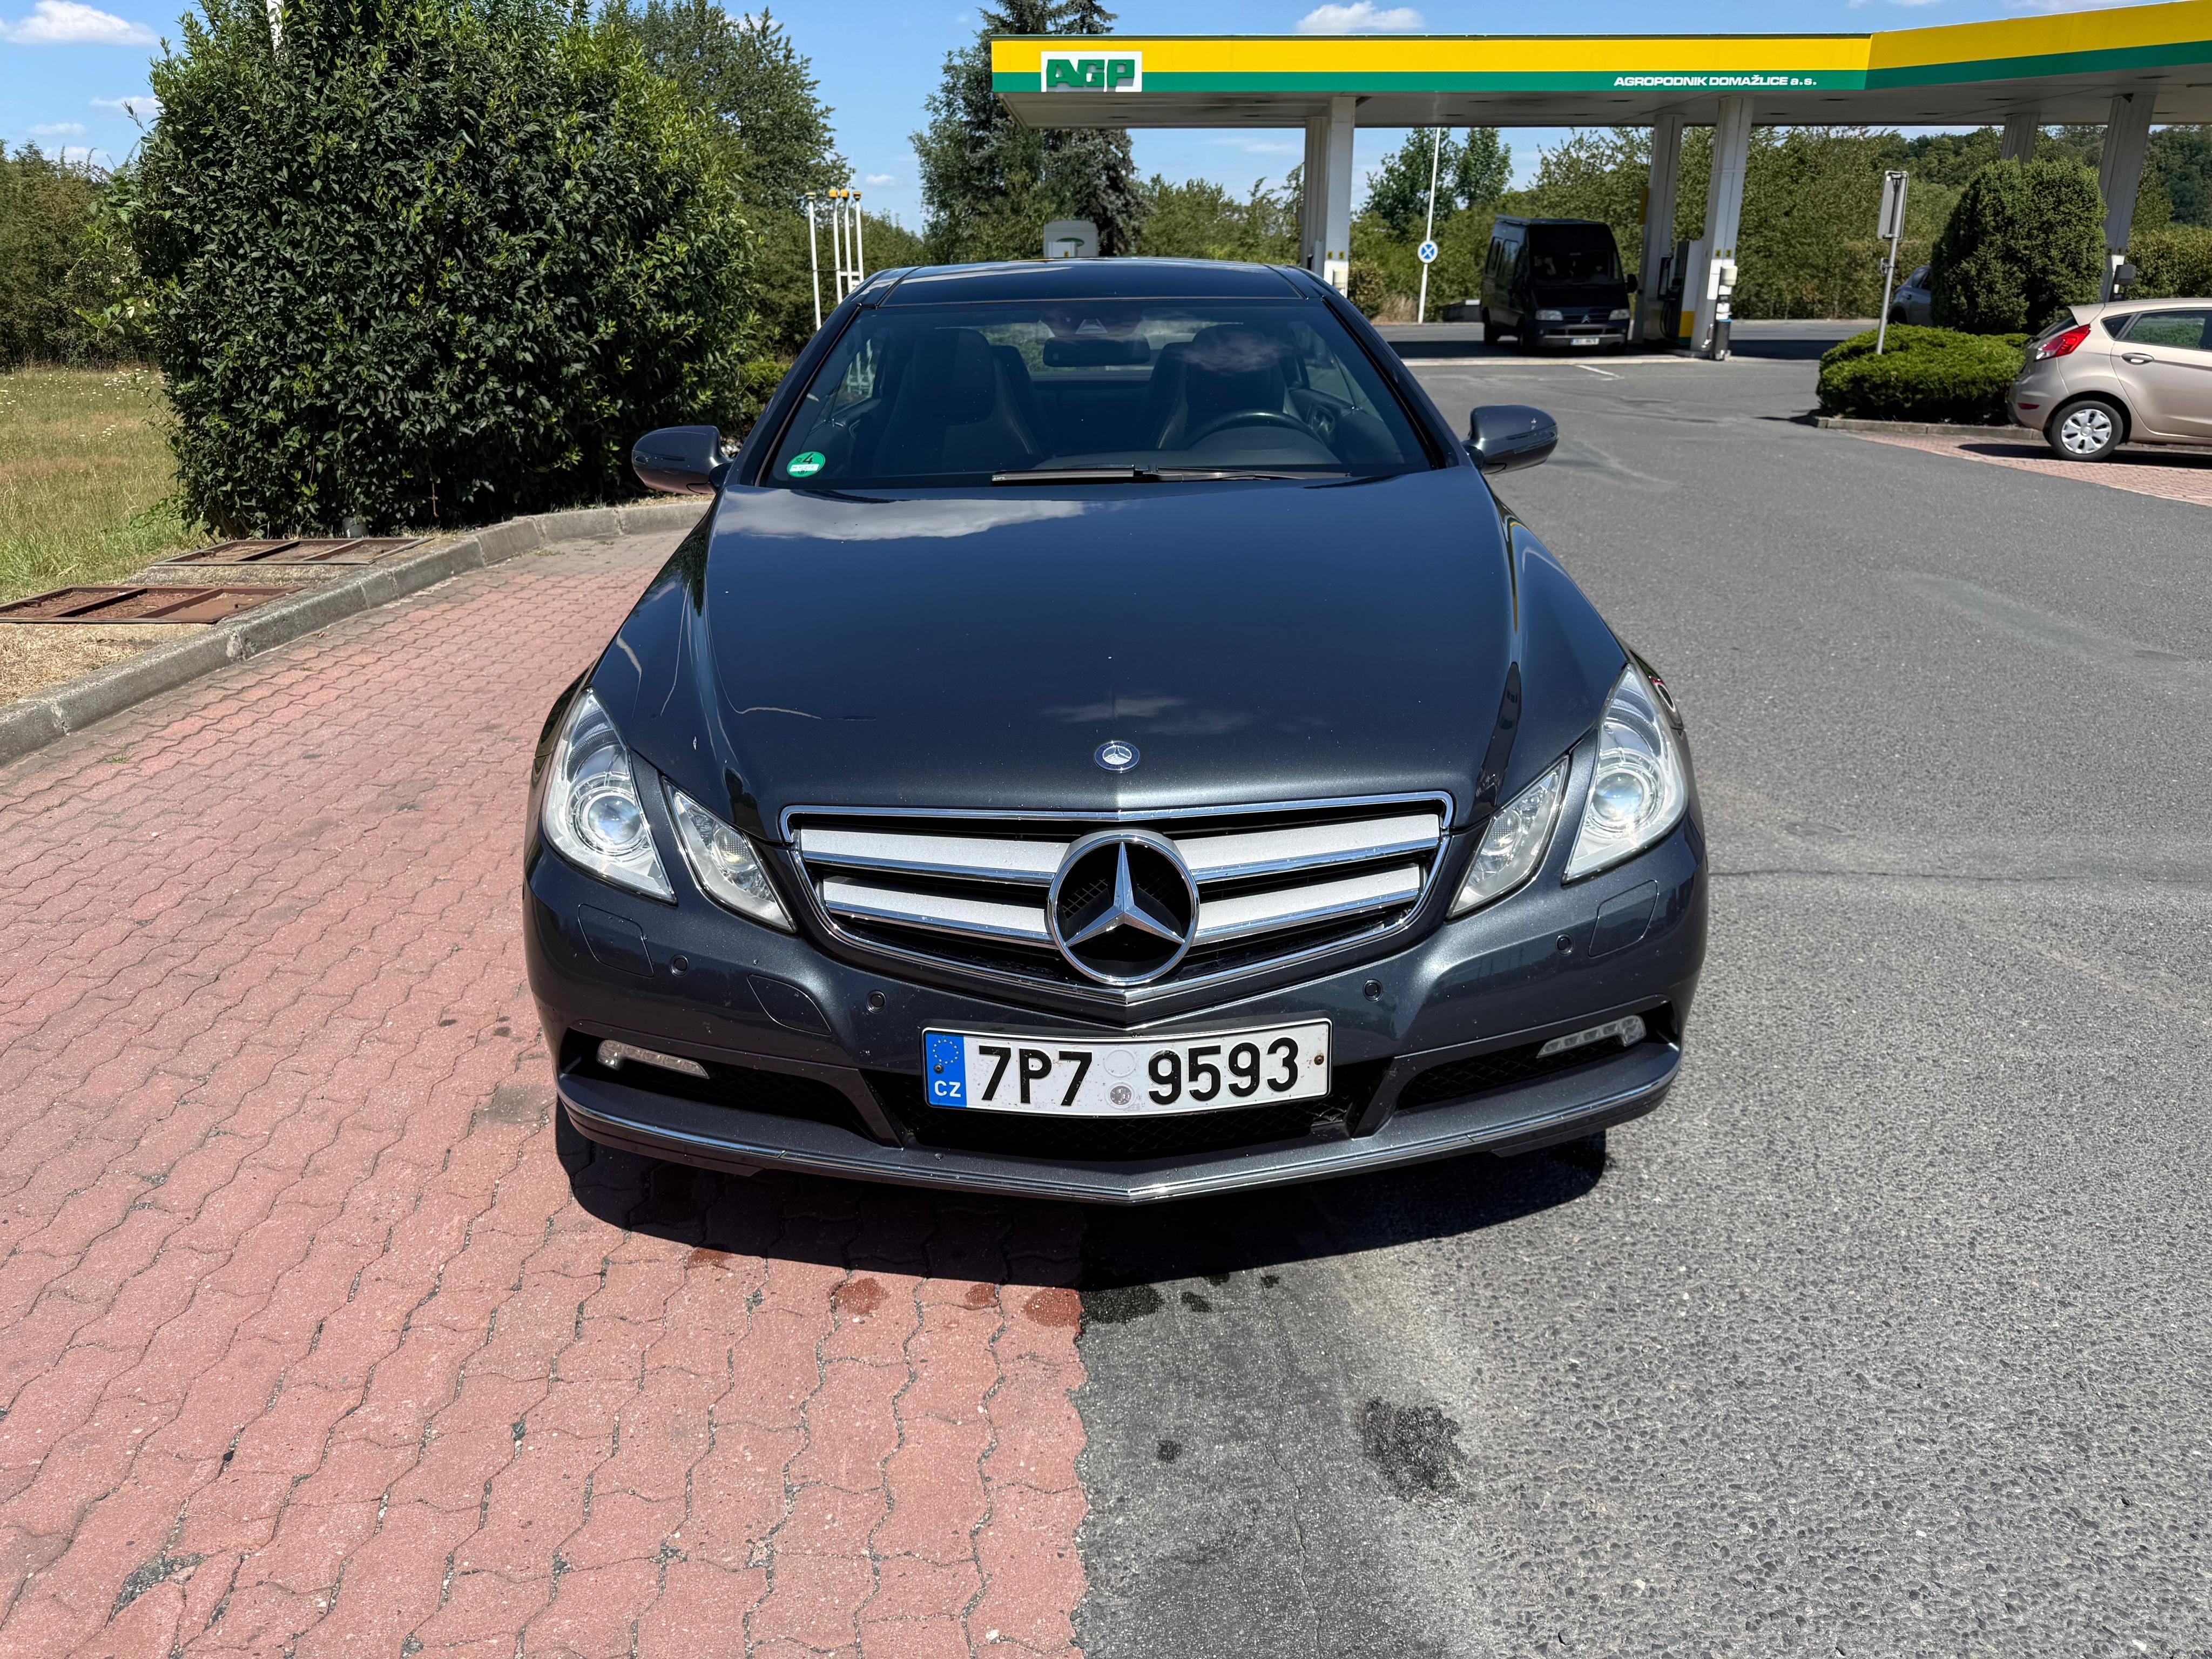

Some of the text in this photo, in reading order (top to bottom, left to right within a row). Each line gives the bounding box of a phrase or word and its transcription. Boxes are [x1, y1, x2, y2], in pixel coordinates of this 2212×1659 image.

[1046, 59, 1135, 87] AGP
[1614, 75, 1817, 86] AGROPODNIK DOMAŽLICE a.s.
[802, 453, 813, 464] 4
[979, 1037, 1299, 1107] 7P7 9593
[934, 1080, 962, 1098] CZ
